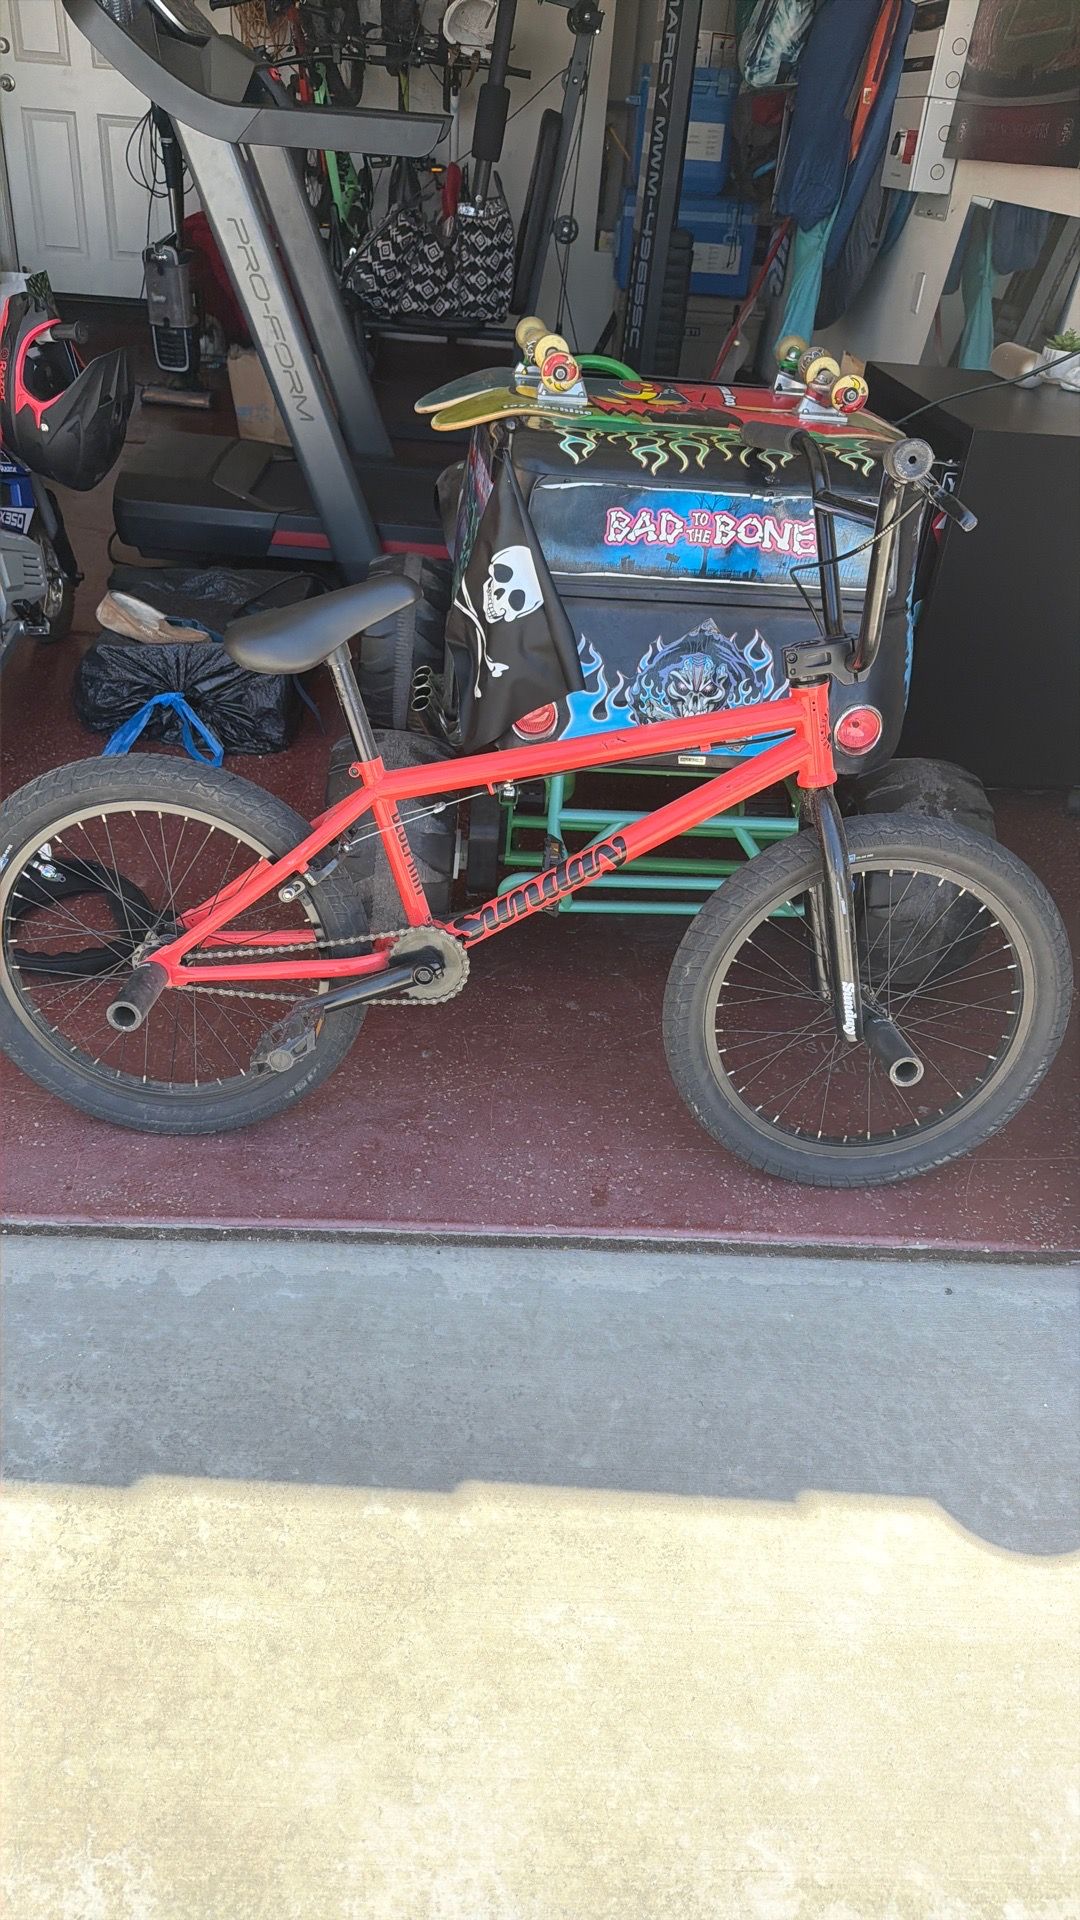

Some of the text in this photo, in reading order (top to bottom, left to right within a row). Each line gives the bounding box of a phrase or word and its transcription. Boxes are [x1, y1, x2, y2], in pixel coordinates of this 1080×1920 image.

[658, 0, 682, 109] ARCY
[226, 217, 315, 422] PRO-FORM
[606, 508, 817, 555] BAD TO THE BONE
[841, 981, 858, 1036] Sunday
